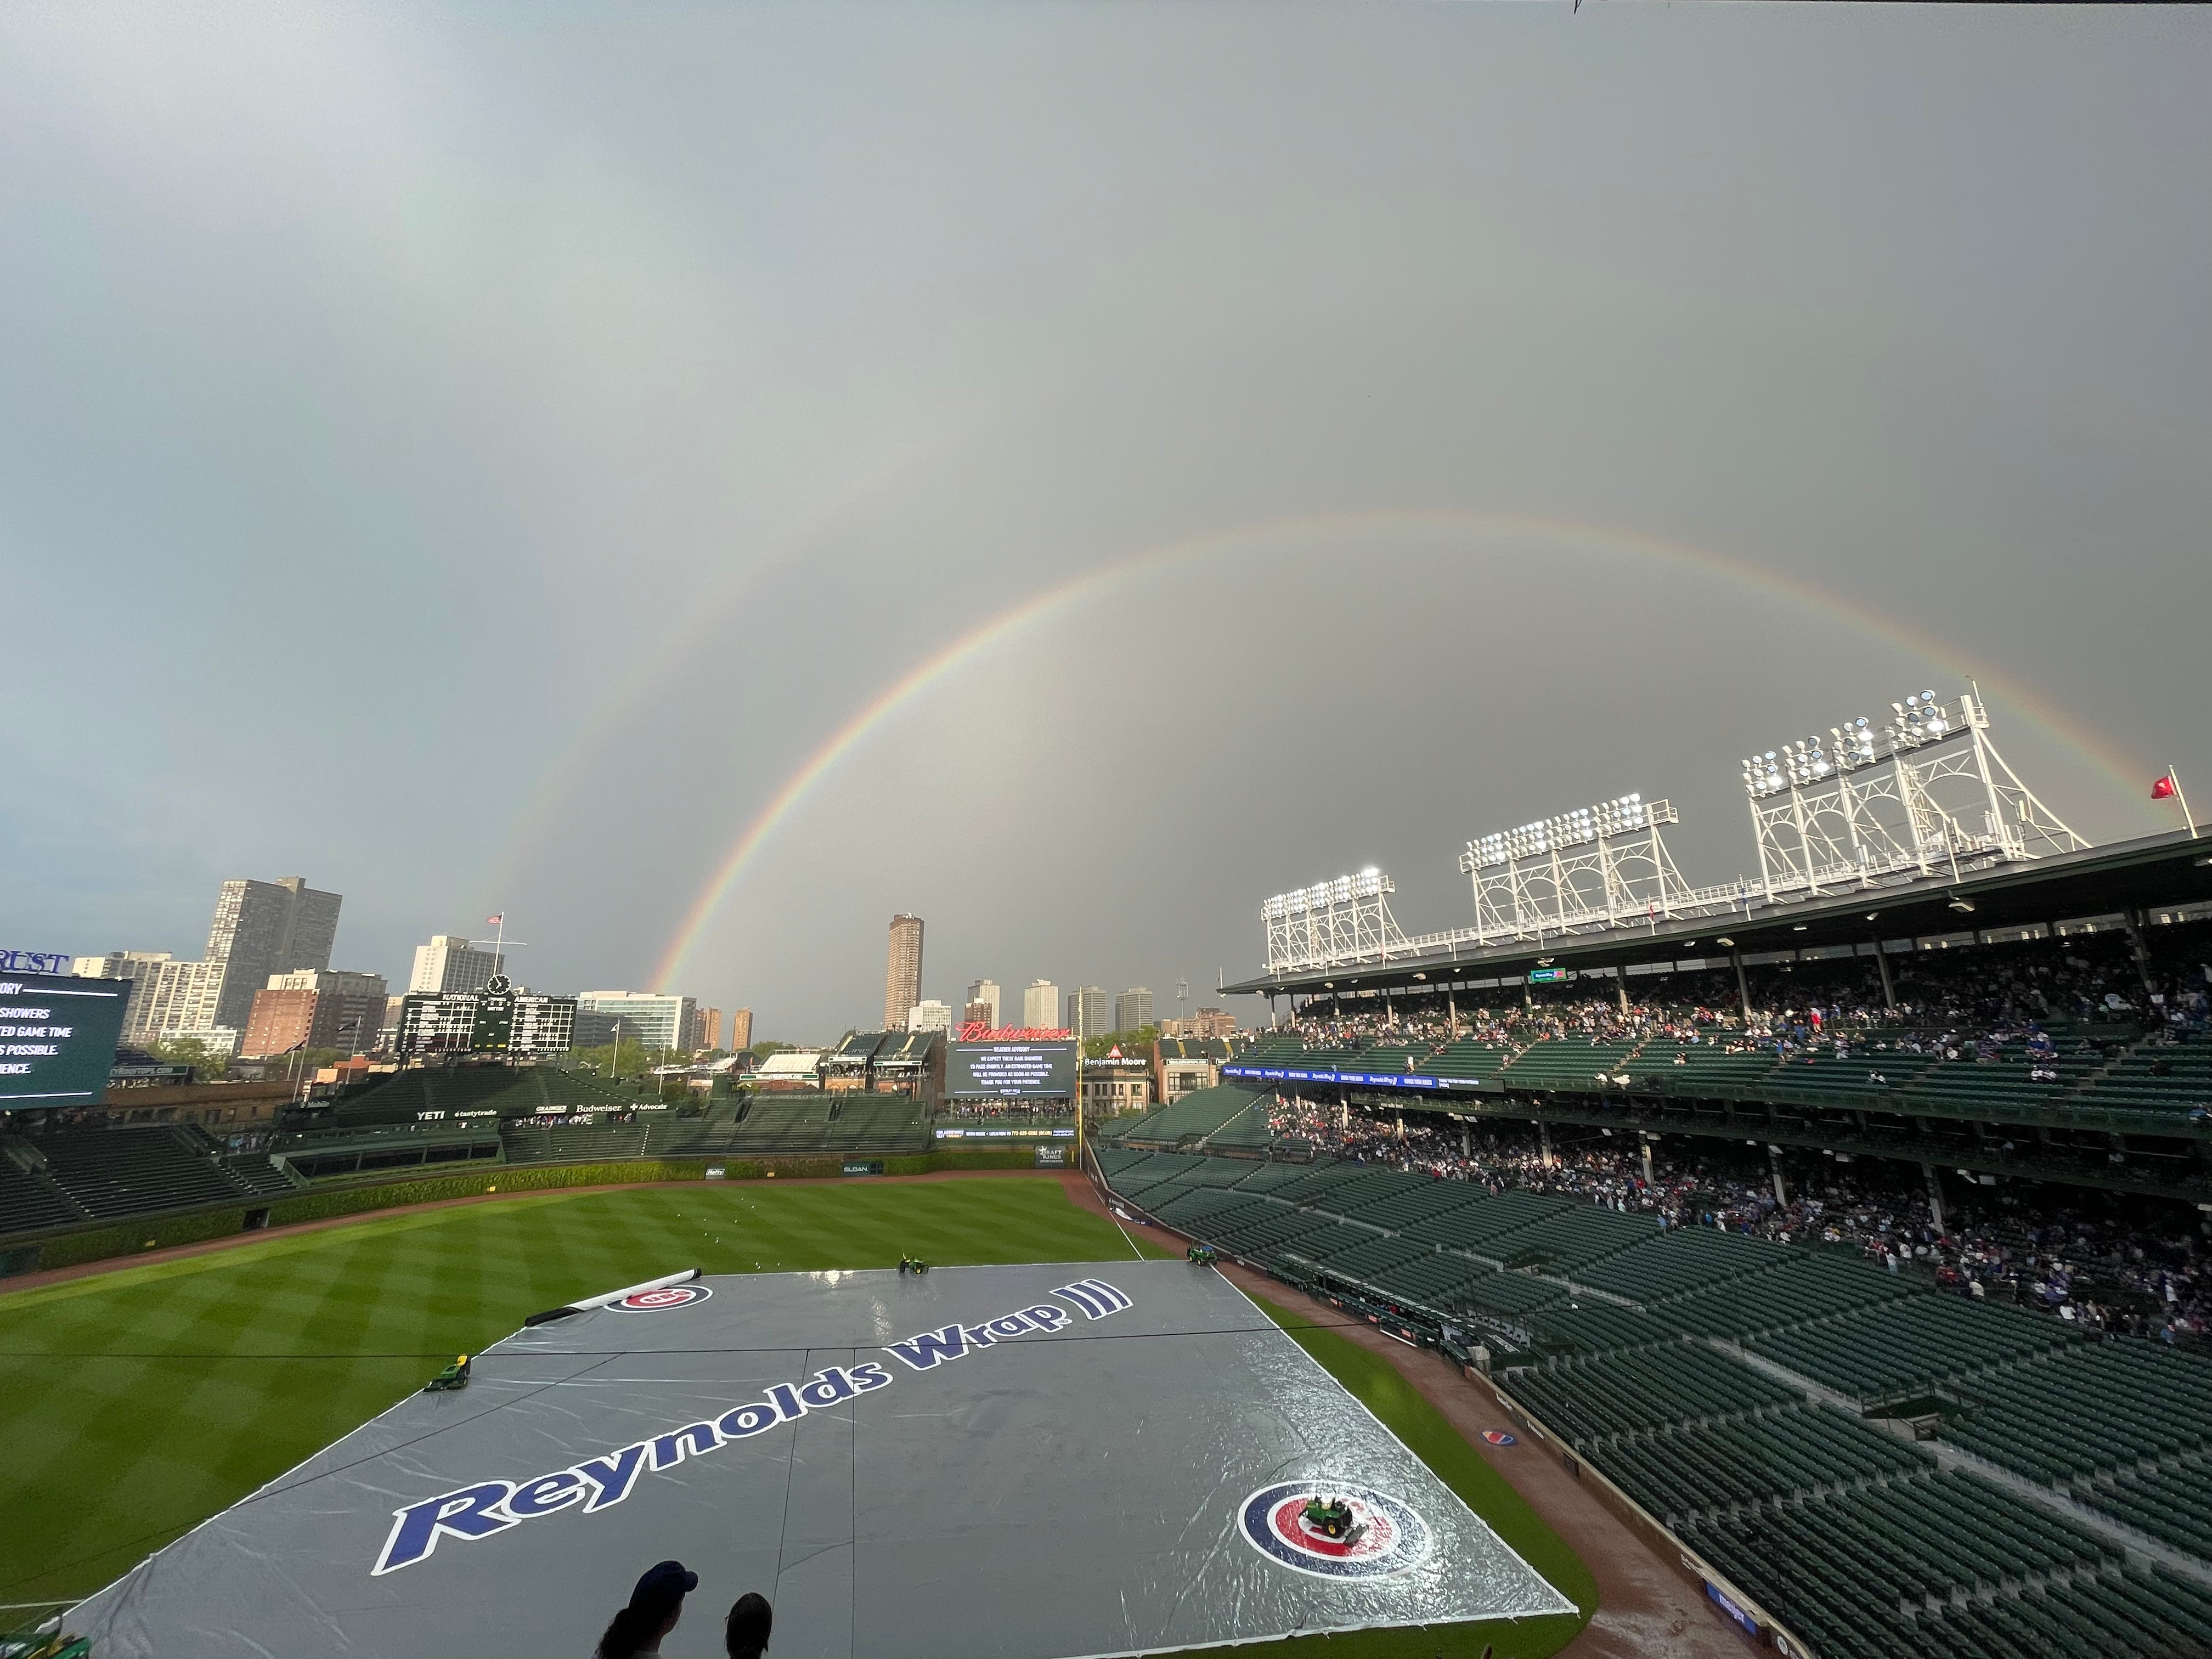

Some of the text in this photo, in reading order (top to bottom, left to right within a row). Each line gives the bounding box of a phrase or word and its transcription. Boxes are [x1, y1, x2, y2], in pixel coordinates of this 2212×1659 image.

[0, 983, 22, 995] ORY
[0, 1007, 51, 1019] SHOWERS
[16, 1026, 48, 1037] GAME
[48, 1027, 73, 1037] TIME
[956, 1022, 1071, 1042] Budweiser
[1085, 1058, 1146, 1067] Benjamin Moore
[417, 1110, 445, 1120] YETI
[460, 1109, 498, 1118] tastytrade
[370, 1362, 893, 1576] Reynolds
